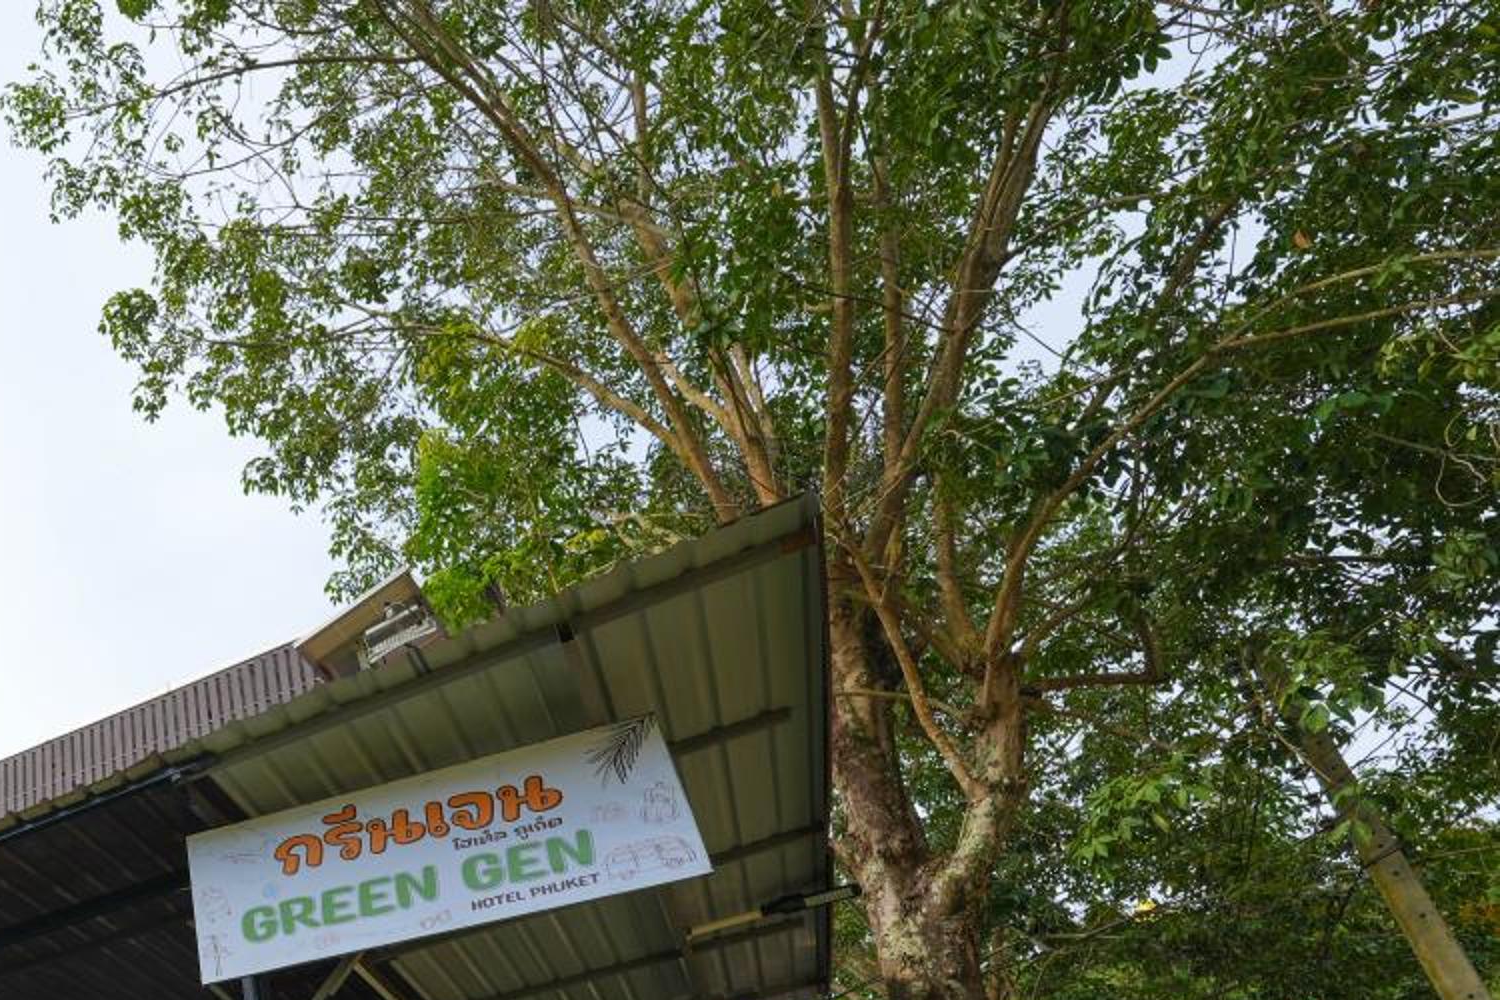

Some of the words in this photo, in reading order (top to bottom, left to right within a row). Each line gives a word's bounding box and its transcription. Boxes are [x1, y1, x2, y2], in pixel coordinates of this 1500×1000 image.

[241, 865, 438, 943] GREEN
[462, 828, 595, 892] GEN
[471, 891, 526, 912] HOTEL
[530, 872, 600, 898] PHUKET
